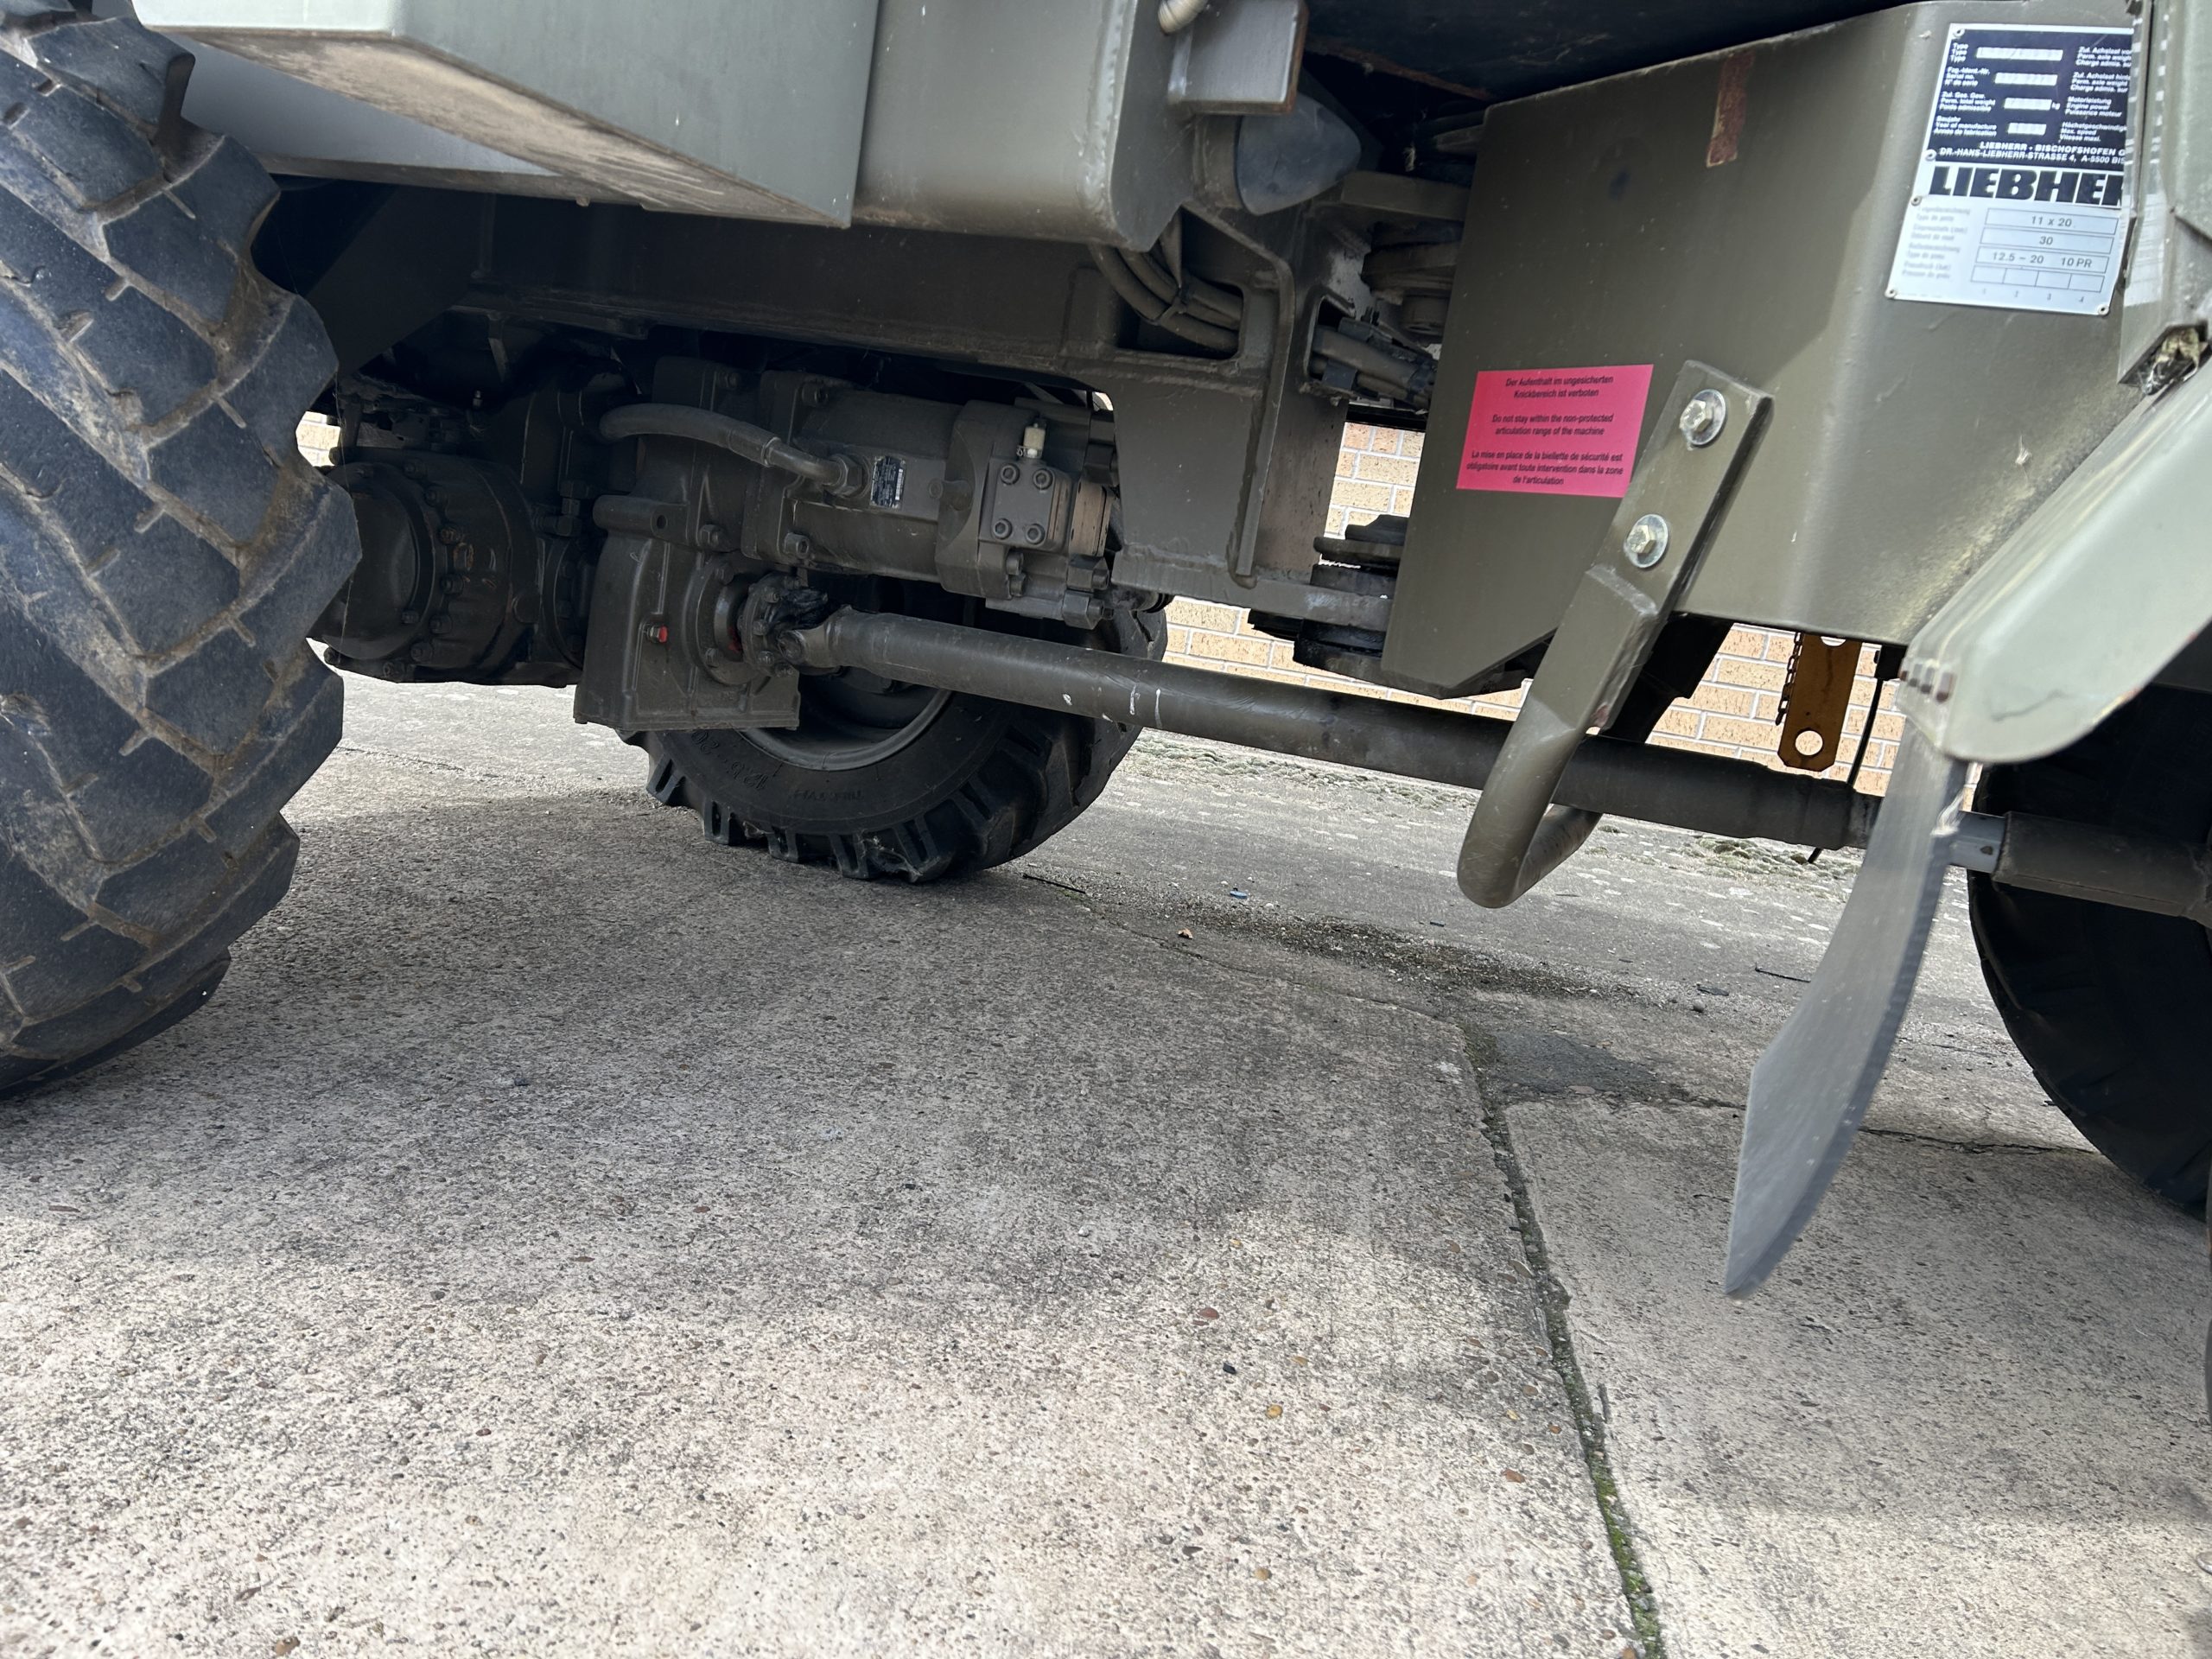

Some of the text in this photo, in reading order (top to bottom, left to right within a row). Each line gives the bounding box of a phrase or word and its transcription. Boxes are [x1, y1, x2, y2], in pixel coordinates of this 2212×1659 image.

[2075, 59, 2100, 67] Charge
[2070, 84, 2094, 92] Charge
[2068, 96, 2112, 105] Motorleistung
[2066, 102, 2089, 111] Engine
[1936, 115, 1961, 124] Baujahr
[1980, 141, 2028, 151] LIEBHERR
[2035, 143, 2117, 156] BISCHOFSHOFEN
[2081, 155, 2110, 163] A-5500
[2031, 215, 2072, 228] 11 x 20
[2039, 236, 2053, 245] 30
[1993, 251, 2015, 262] 12.5
[2030, 254, 2044, 264] 20
[2061, 257, 2074, 266] 10
[2075, 258, 2092, 268] PR
[1505, 378, 1518, 387] Der
[1519, 378, 1553, 386] Aufenthalt
[1563, 375, 1614, 387] ungesicherten
[1514, 388, 1599, 398] Knickbereich ist verboten
[1491, 414, 1502, 423] Do
[1515, 415, 1529, 424] stay
[1529, 414, 1549, 423] within
[1550, 414, 1562, 423] the
[1562, 413, 1614, 423] non-protected
[1495, 427, 1605, 437] articulation range of the machine
[1471, 450, 1480, 459] La
[1505, 451, 1523, 461] place
[1524, 451, 1534, 460] de
[1534, 451, 1541, 460] la
[1541, 451, 1568, 461] biellette
[1570, 452, 1580, 461] de
[1581, 452, 1610, 461] sécurité
[1466, 462, 1499, 473] obligatoire
[1499, 463, 1518, 472] avant
[1518, 464, 1535, 473] toute
[1536, 464, 1578, 474] intervention
[1579, 465, 1597, 474] dans
[1597, 466, 1605, 475] la
[1513, 474, 1564, 485] de l'articulation
